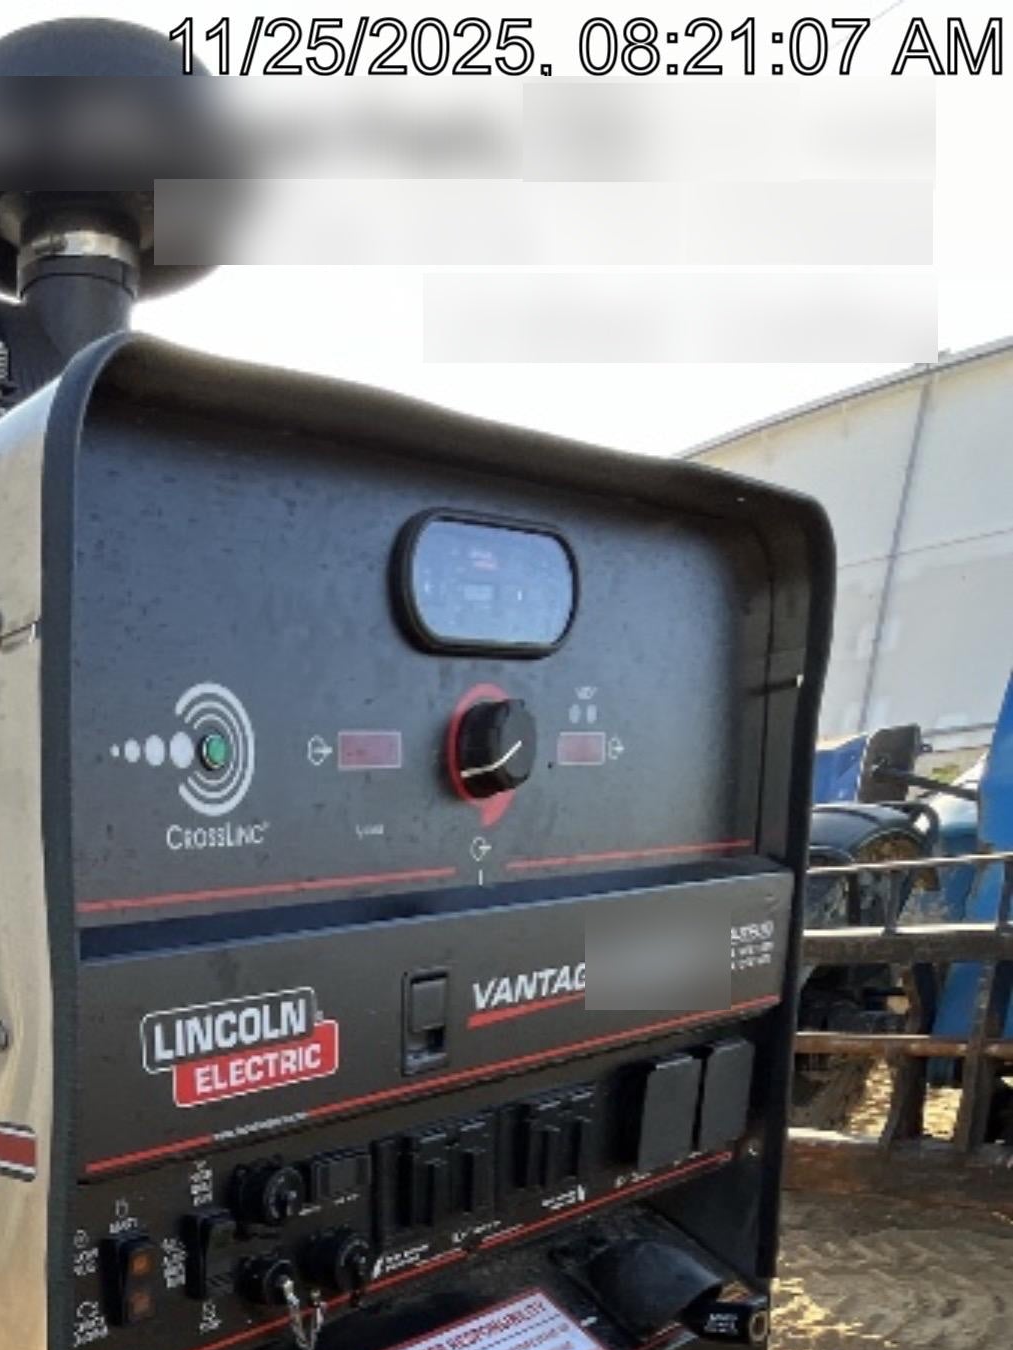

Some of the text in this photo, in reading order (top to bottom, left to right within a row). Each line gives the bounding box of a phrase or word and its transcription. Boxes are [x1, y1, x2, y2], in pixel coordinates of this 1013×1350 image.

[471, 960, 586, 1010] VANTAG
[153, 998, 307, 1063] LINCOLN
[194, 1043, 322, 1096] ELECTRIC
